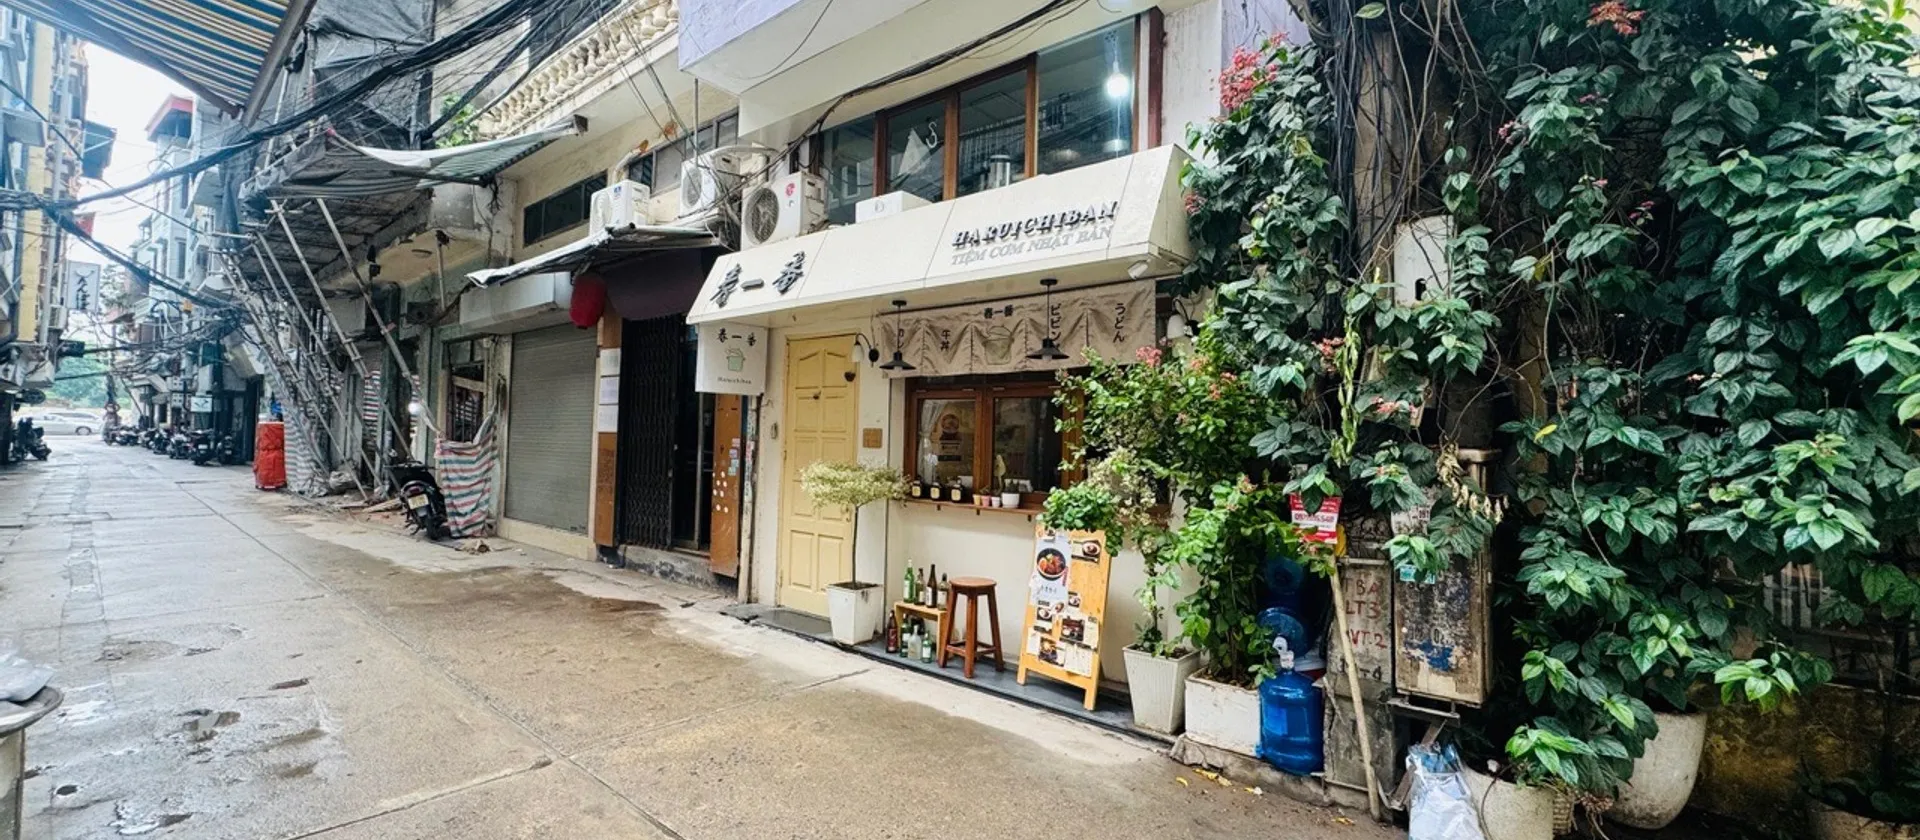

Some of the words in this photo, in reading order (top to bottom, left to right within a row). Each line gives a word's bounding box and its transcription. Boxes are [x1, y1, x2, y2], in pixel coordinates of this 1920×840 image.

[952, 200, 1118, 250] HARUICHIBAN
[951, 249, 986, 266] TIỆM
[1028, 234, 1074, 253] NHẬT
[1112, 302, 1126, 344] うどん
